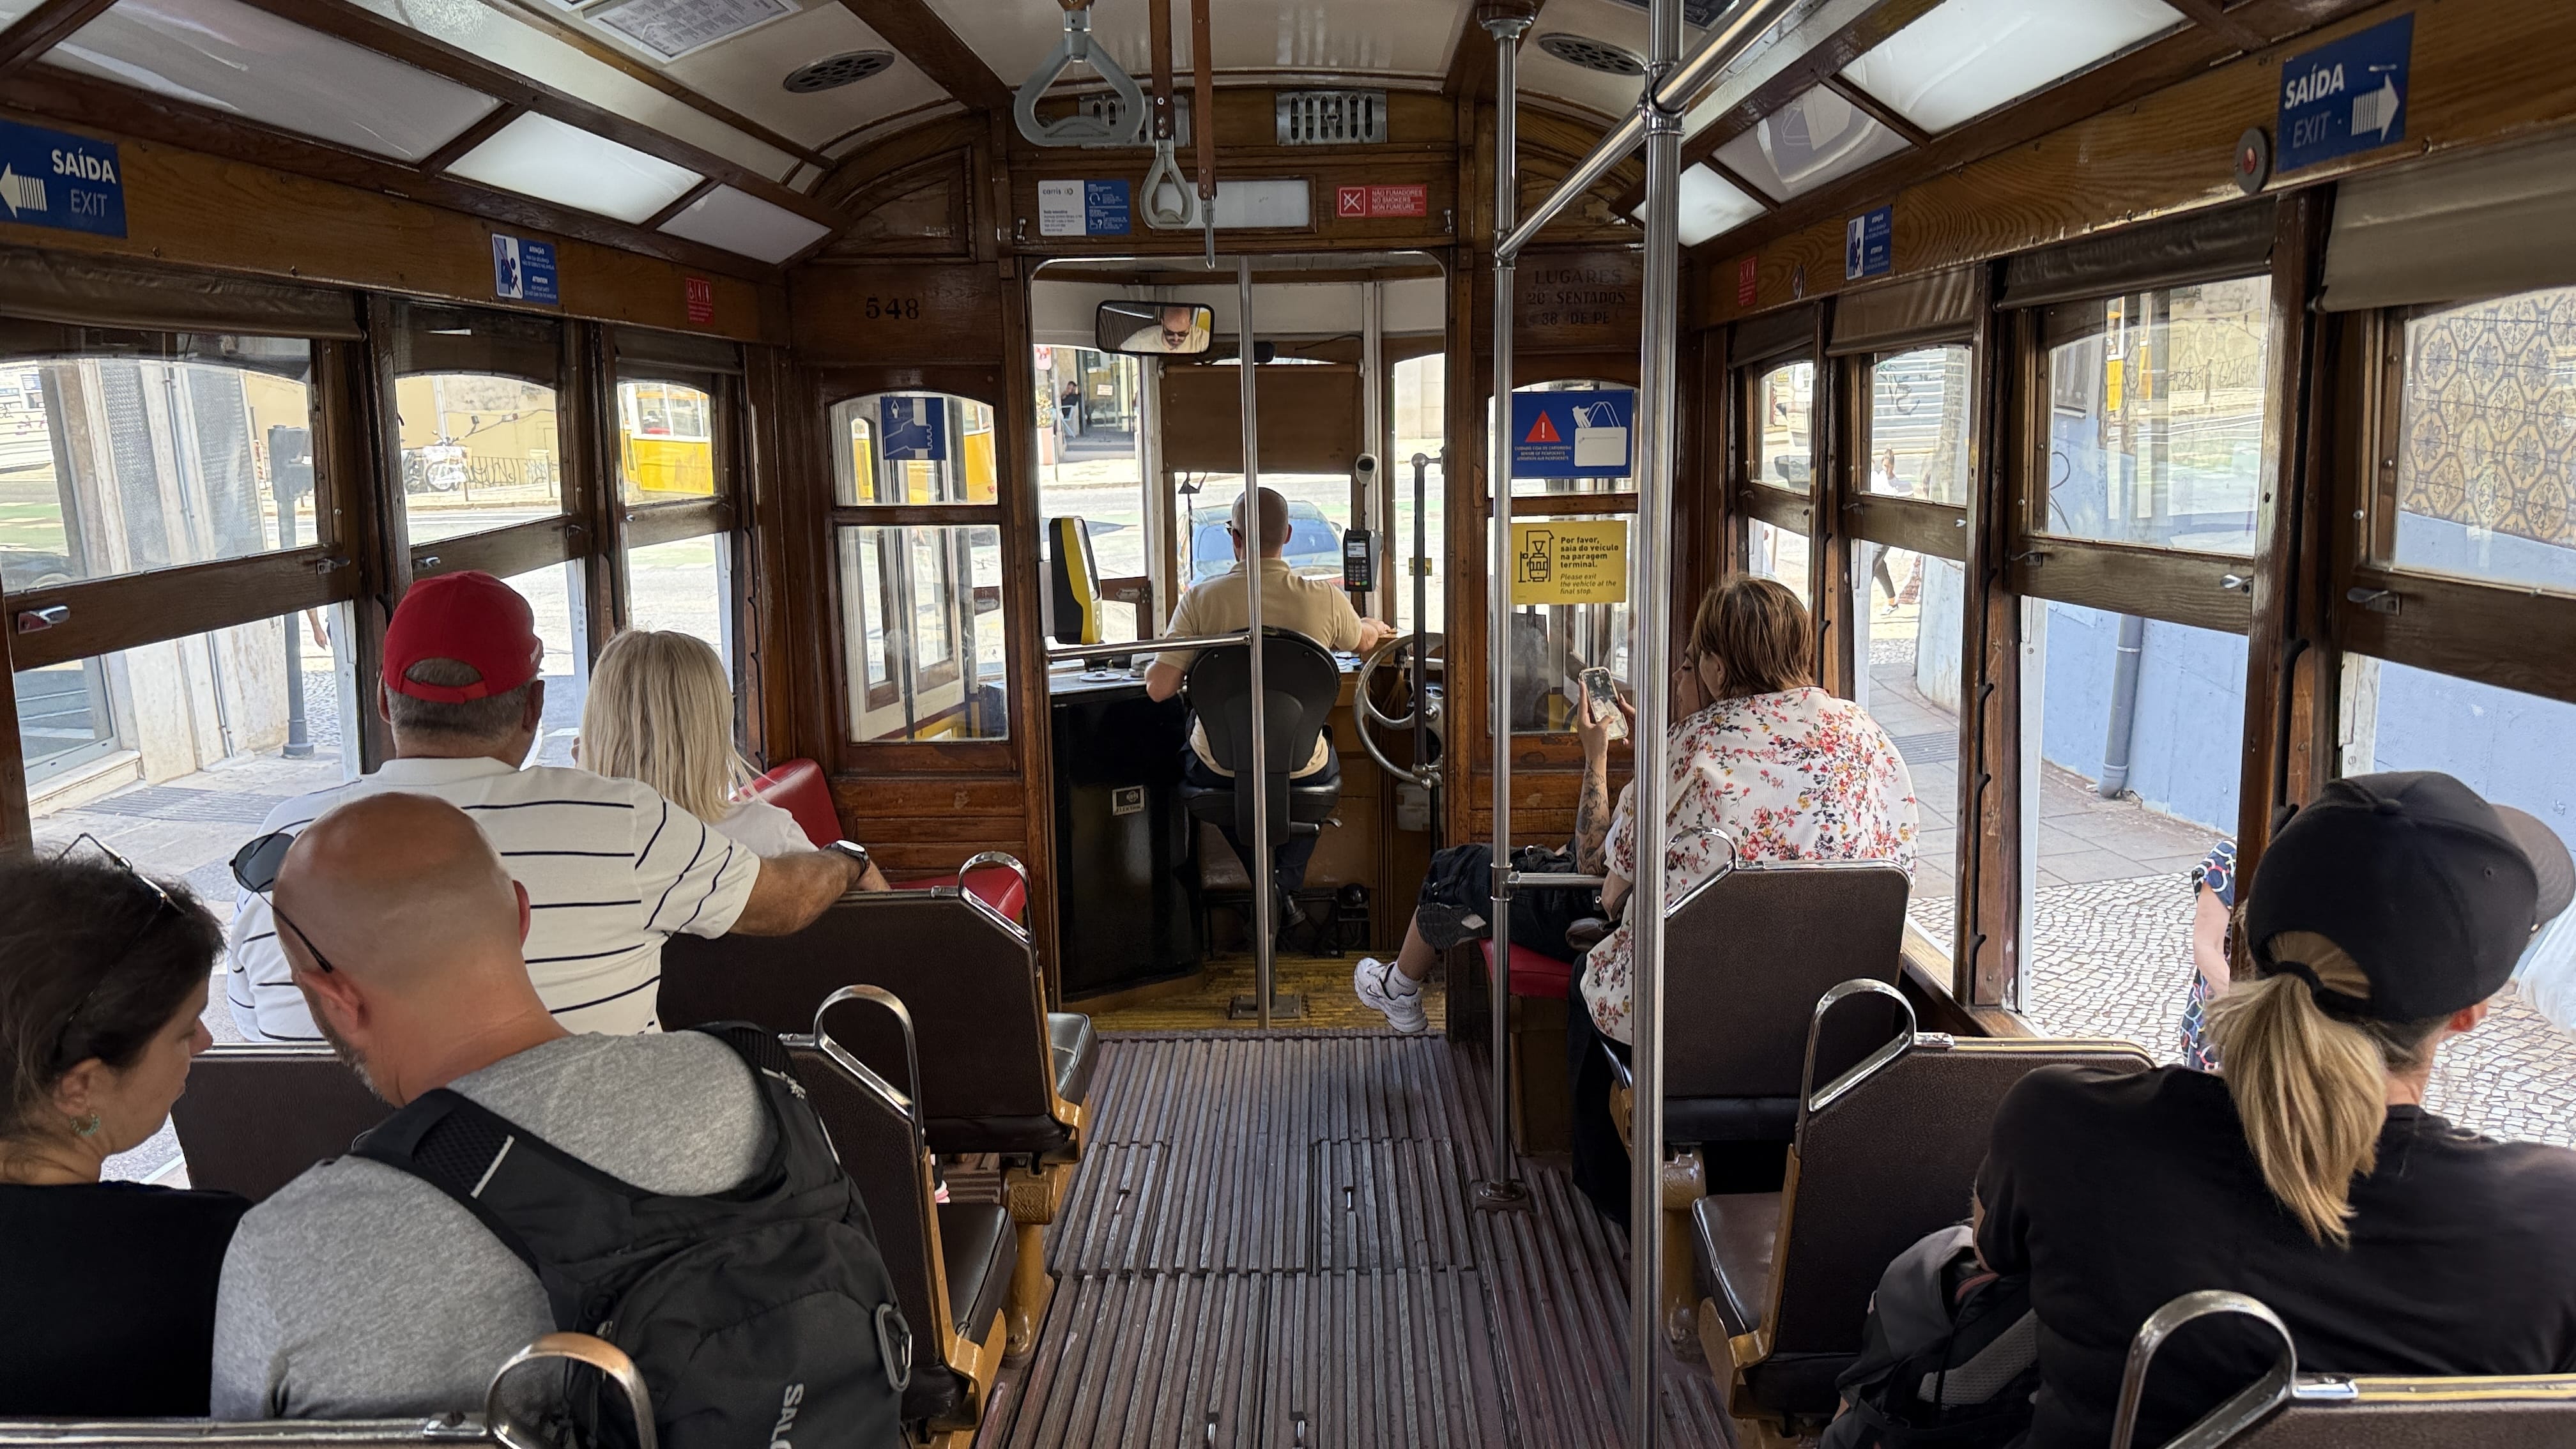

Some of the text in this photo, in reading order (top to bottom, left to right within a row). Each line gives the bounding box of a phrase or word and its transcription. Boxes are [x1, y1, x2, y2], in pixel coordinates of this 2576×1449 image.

[2284, 63, 2344, 109] SAÍDA
[2293, 111, 2331, 148] EXIT
[51, 147, 116, 184] SAÍDA
[1043, 187, 1062, 195] carris
[70, 188, 107, 217] EXIT
[1535, 269, 1621, 284] LUGARES
[866, 297, 919, 319] 548
[1556, 291, 1625, 305] SENTADOS
[1570, 312, 1586, 325] DE
